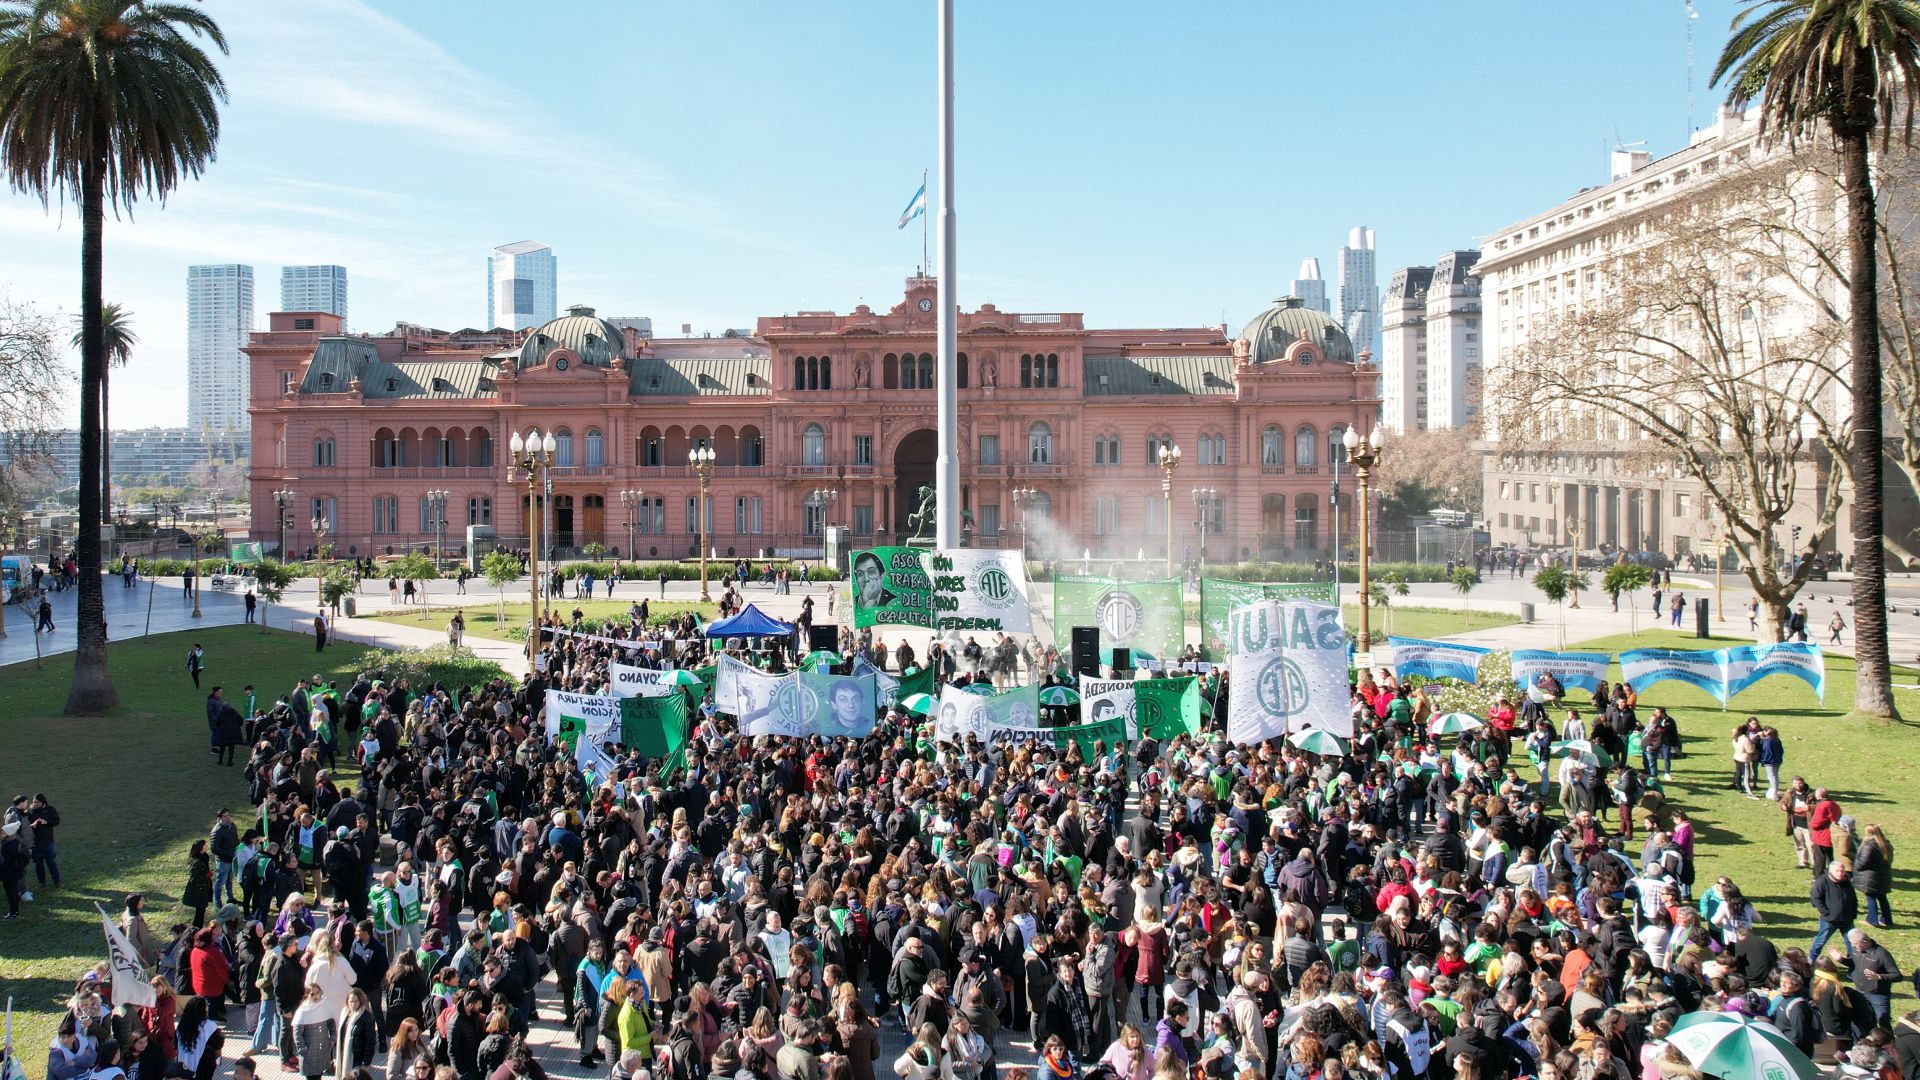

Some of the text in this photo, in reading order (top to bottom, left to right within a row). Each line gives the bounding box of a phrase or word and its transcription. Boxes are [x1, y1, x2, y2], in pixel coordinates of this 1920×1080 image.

[892, 553, 953, 571] ASOCIÓN
[982, 570, 1008, 598] ATE
[902, 592, 922, 607] DEL
[876, 610, 1003, 631] CAPITA FEDERAL
[1106, 601, 1134, 637] ATE
[1766, 1069, 1785, 1080] ATE
